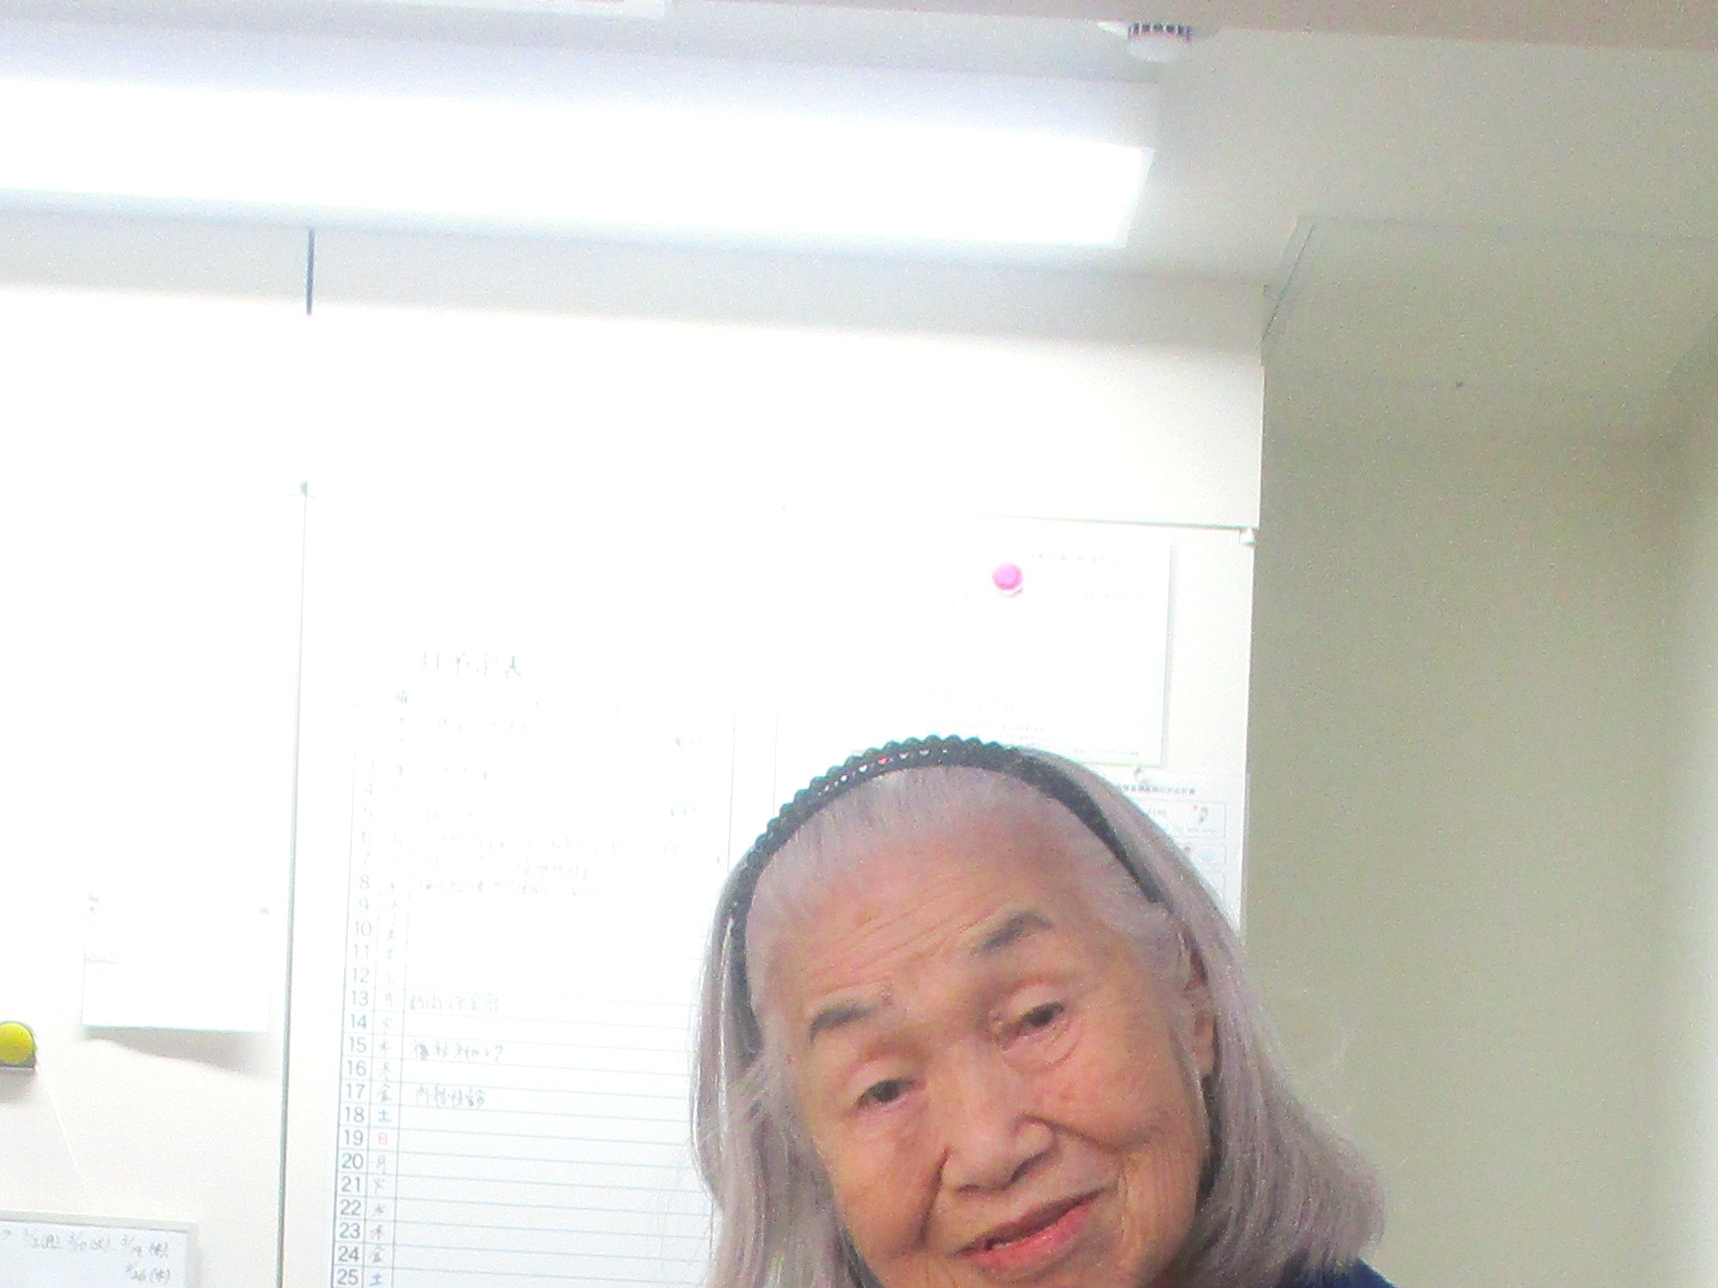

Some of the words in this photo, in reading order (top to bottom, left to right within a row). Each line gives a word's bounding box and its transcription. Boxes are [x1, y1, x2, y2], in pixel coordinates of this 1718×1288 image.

[359, 875, 370, 889] 8
[359, 897, 369, 912] 9
[355, 921, 373, 936] 10
[353, 943, 369, 958] 11
[353, 967, 370, 983] 12
[352, 990, 369, 1008] 13
[351, 1014, 367, 1029] 14
[349, 1036, 367, 1053] 15
[347, 1060, 367, 1076] 16
[346, 1082, 365, 1099] 17
[345, 1106, 365, 1124] 18
[344, 1129, 364, 1147] 19
[341, 1152, 365, 1170] 20
[341, 1176, 361, 1193] 21
[340, 1199, 361, 1217] 22
[339, 1222, 360, 1239] 23
[338, 1245, 359, 1262] 24
[337, 1268, 358, 1286] 25
